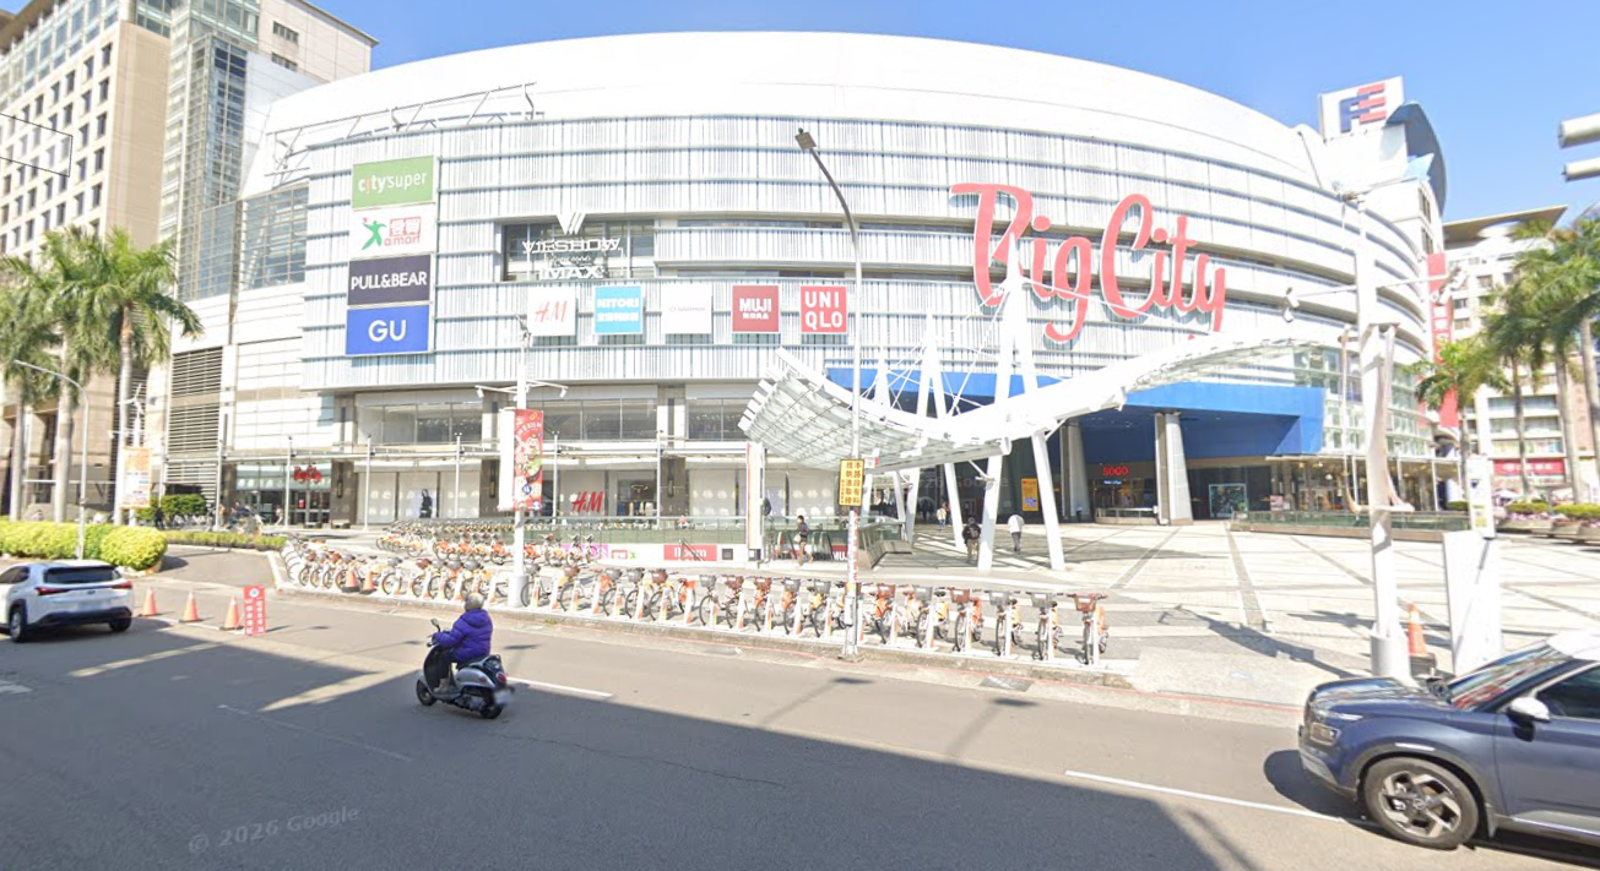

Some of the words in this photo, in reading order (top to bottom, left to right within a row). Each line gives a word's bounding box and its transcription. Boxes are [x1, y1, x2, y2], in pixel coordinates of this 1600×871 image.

[521, 238, 621, 254] VIESHOW
[951, 183, 1092, 342] Big
[1100, 194, 1226, 339] City
[351, 271, 428, 290] PULL&BEAR
[597, 298, 639, 308] NITORI
[739, 298, 772, 312] MUJI
[805, 291, 840, 308] UNI
[805, 311, 843, 330] QLO
[368, 320, 406, 342] GU
[1103, 465, 1129, 477] SOGO
[571, 491, 605, 513] H&M
